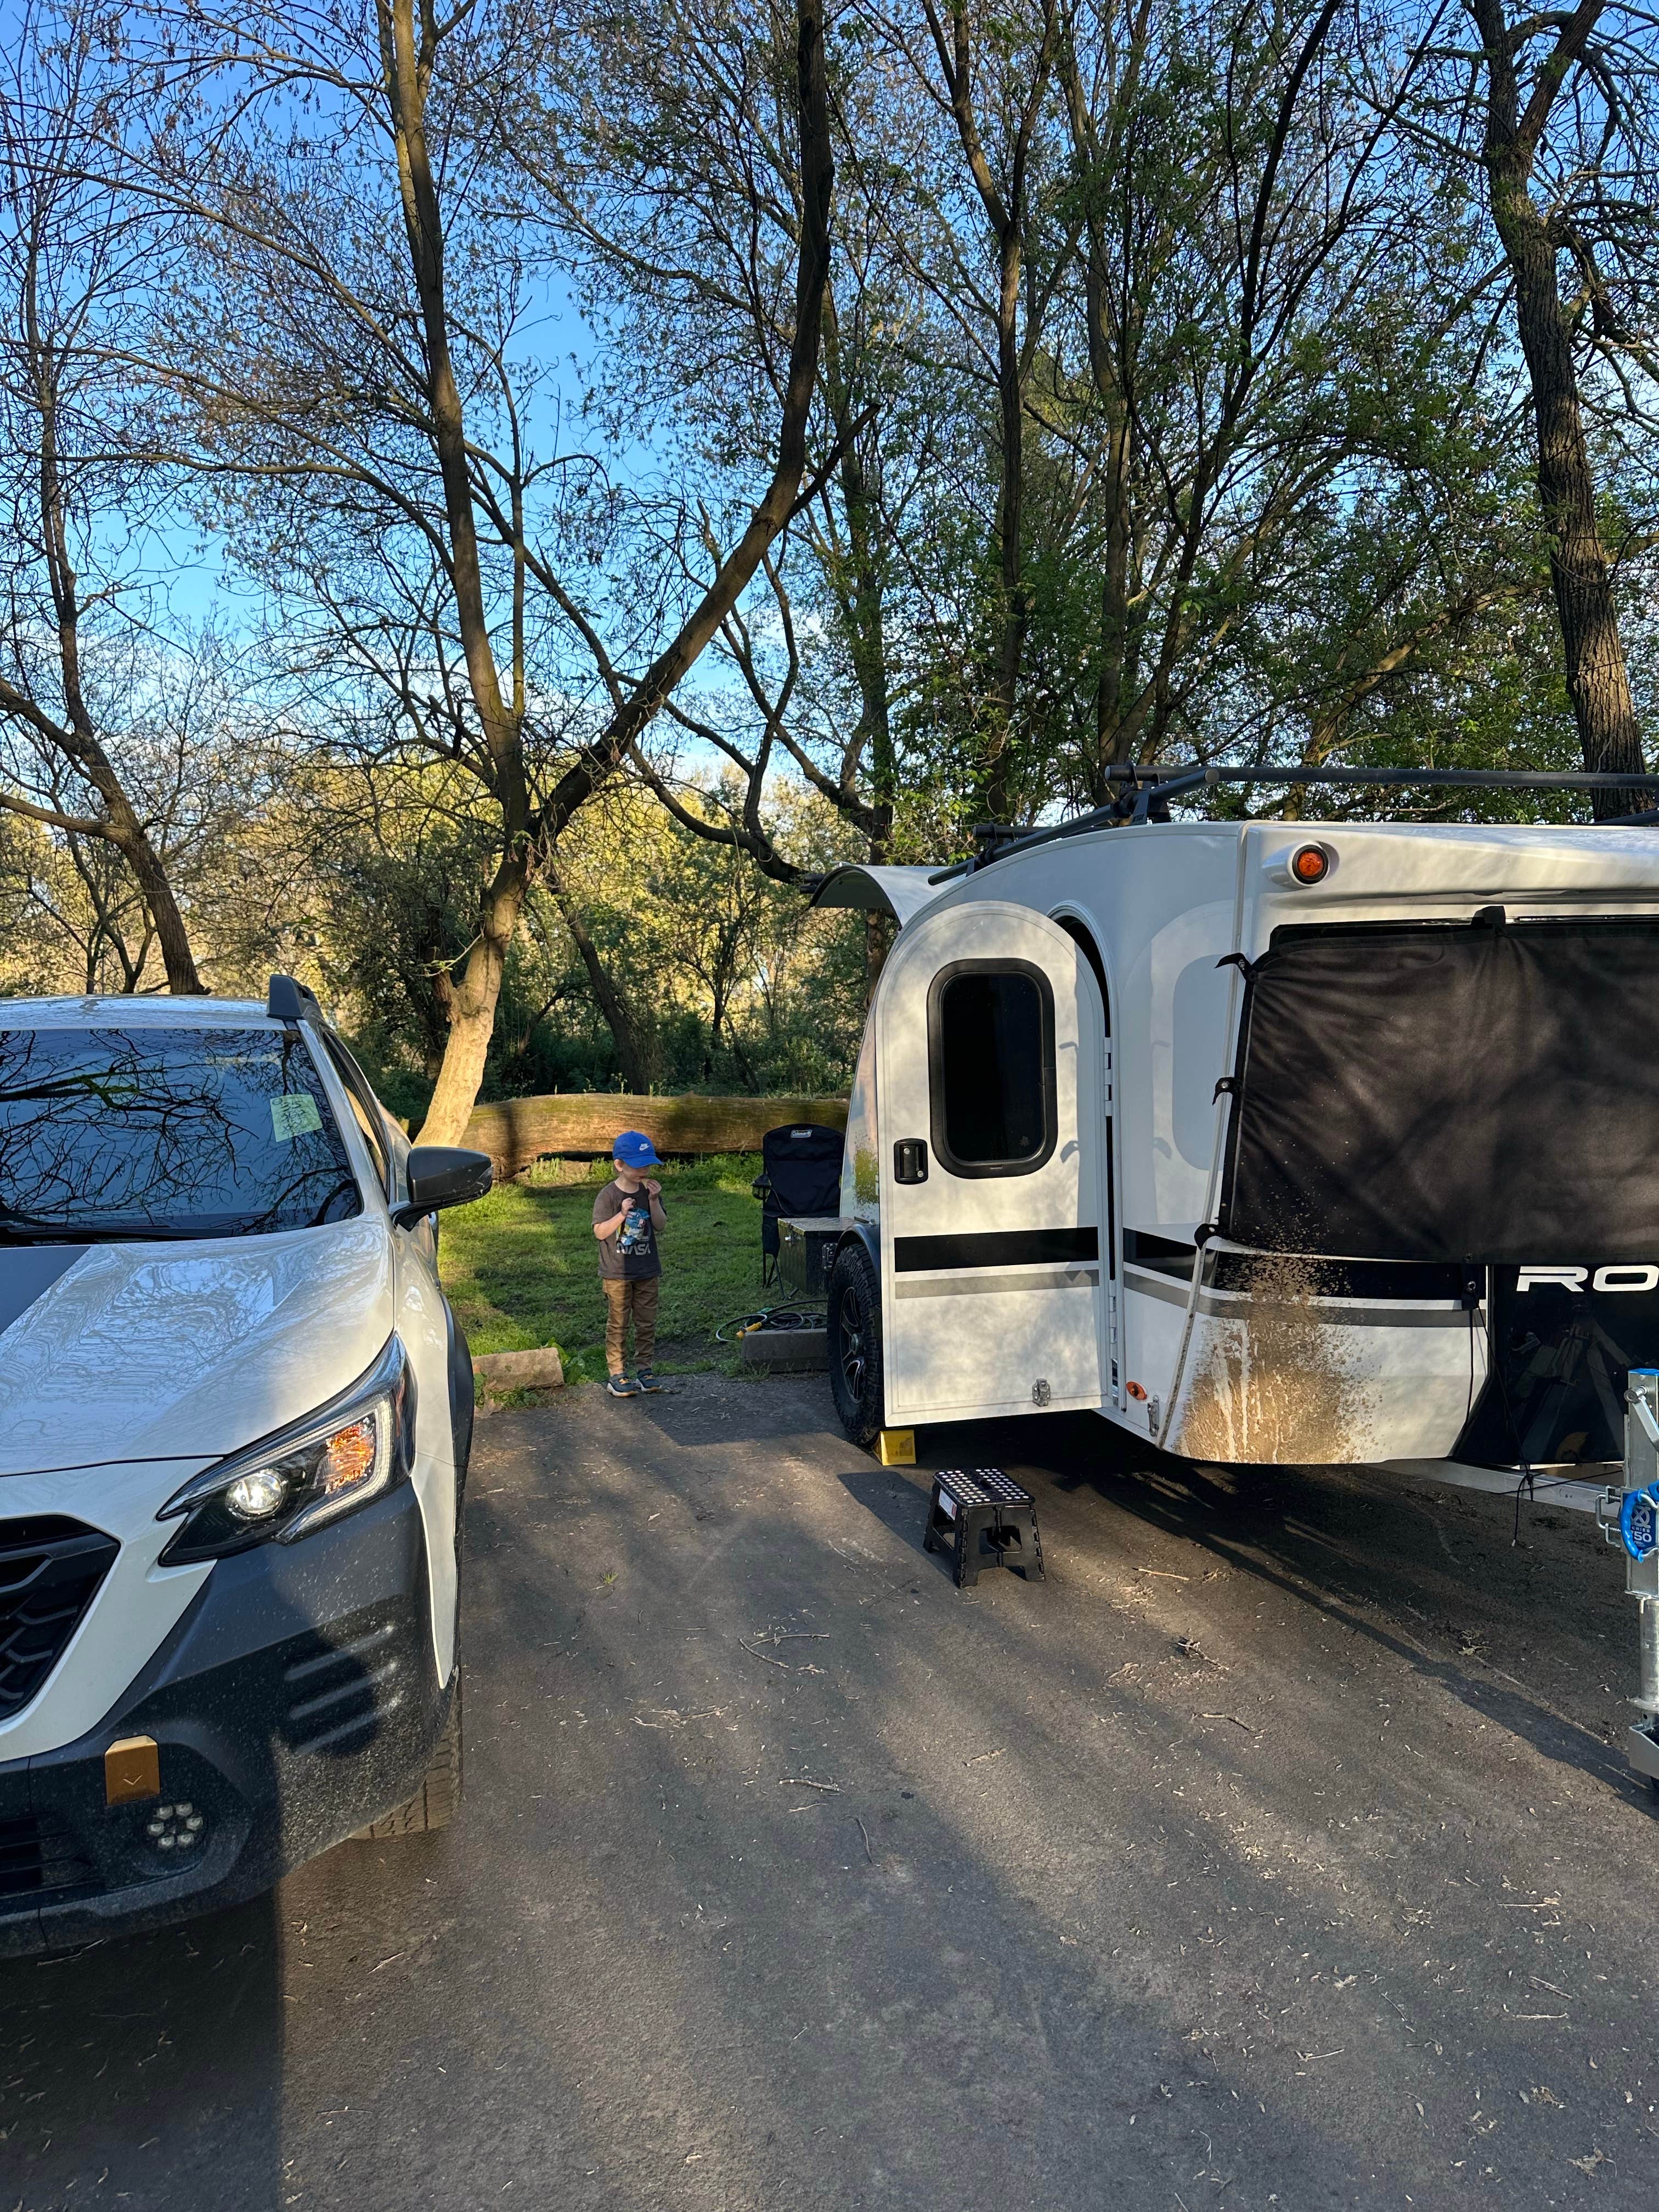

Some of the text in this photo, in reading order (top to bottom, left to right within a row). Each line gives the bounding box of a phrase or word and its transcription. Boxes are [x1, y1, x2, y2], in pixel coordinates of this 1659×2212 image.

[616, 1243, 651, 1255] NASA
[1516, 1265, 1659, 1292] RO
[1631, 1530, 1652, 1543] 50
